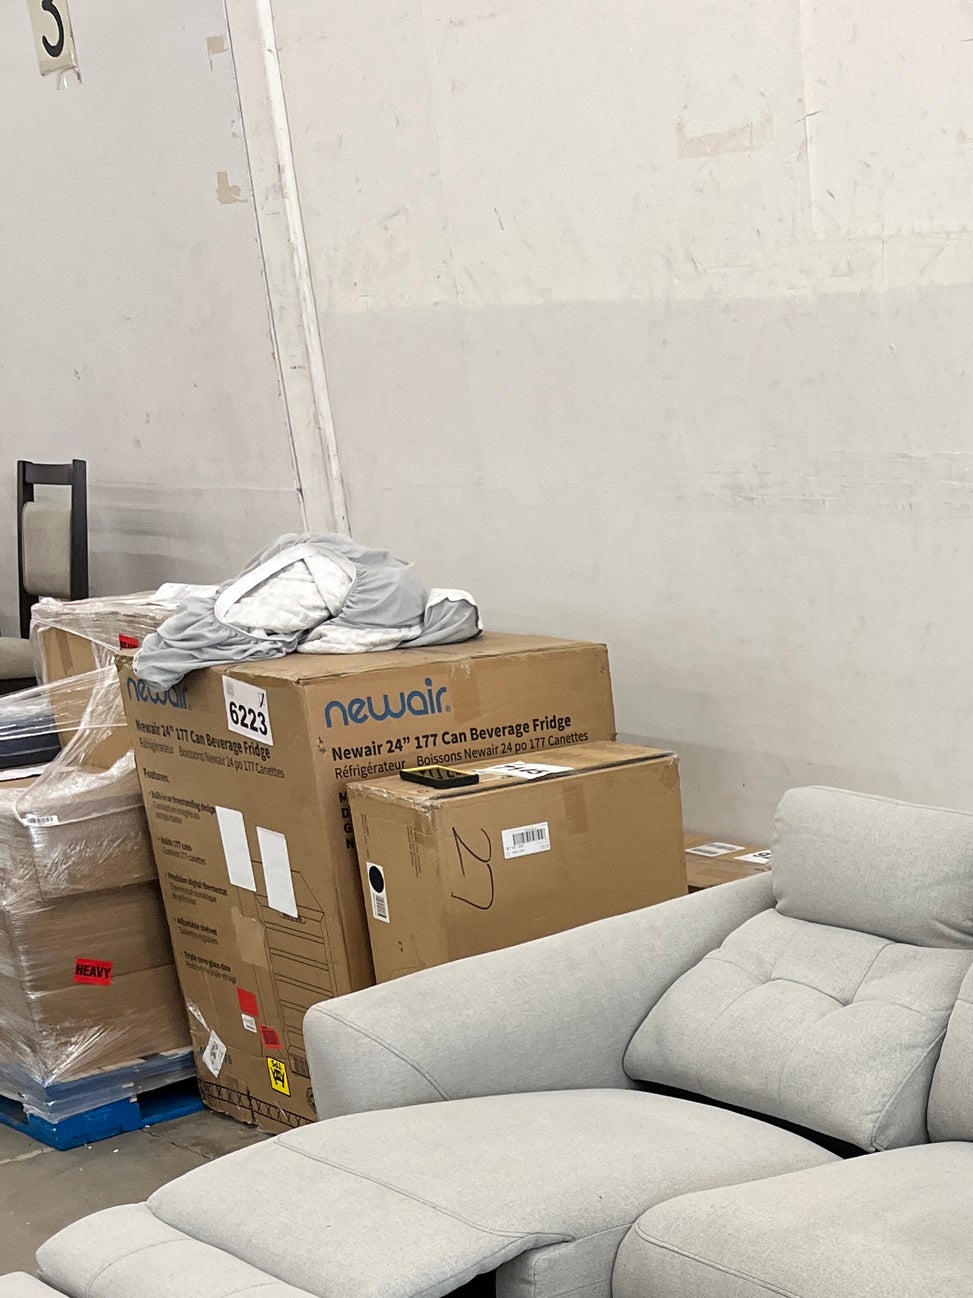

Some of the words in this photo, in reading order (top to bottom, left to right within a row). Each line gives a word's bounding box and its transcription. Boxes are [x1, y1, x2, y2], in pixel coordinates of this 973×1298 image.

[230, 701, 267, 735] 6223
[324, 677, 447, 728] newair
[176, 727, 189, 742] 177
[190, 730, 206, 746] Can
[206, 734, 243, 756] Beverage
[244, 741, 271, 761] Fridge
[332, 741, 383, 761] Newair
[415, 733, 438, 749] 177
[441, 731, 467, 745] Can
[470, 722, 530, 740] Beverage
[532, 715, 571, 732] Fridge
[334, 760, 406, 779] Réfrigérateur
[416, 749, 462, 767] Boissons
[464, 744, 499, 760] Newair
[501, 742, 513, 754] 24
[515, 742, 527, 755] po
[530, 737, 546, 750] 177
[548, 731, 589, 746] Canettes
[76, 964, 111, 979] HEAVY
